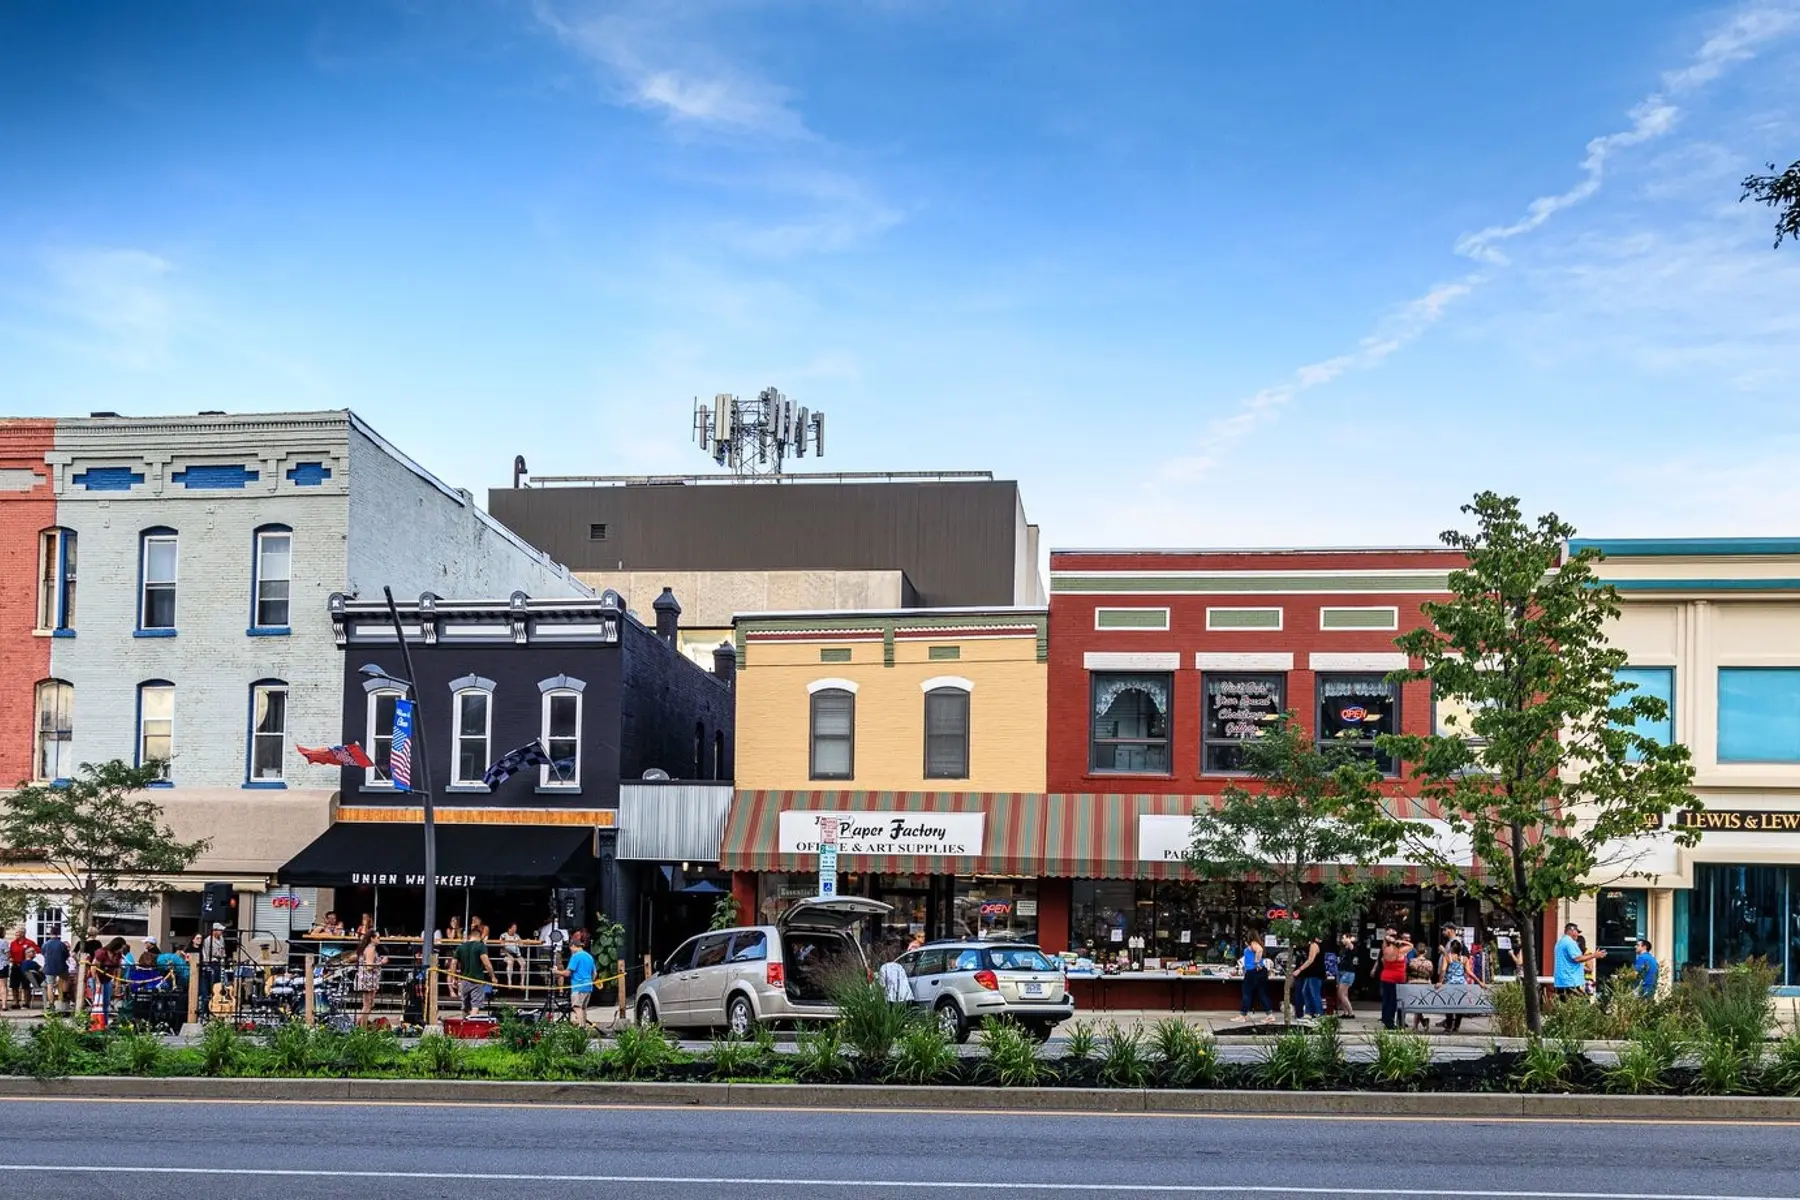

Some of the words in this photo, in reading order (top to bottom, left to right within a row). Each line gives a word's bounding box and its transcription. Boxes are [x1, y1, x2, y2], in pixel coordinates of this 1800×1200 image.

[1341, 709, 1367, 719] OPEN
[1686, 813, 1741, 829] LEWIS
[1744, 815, 1759, 829] &
[1761, 813, 1800, 829] LEW
[840, 821, 884, 839] Paper
[889, 818, 947, 841] Factory
[796, 842, 848, 852] OFE
[852, 843, 863, 852] &
[866, 843, 896, 853] ART
[897, 843, 965, 854] SUPPLIES
[352, 873, 398, 885] UNION
[980, 903, 1012, 914] OPEN
